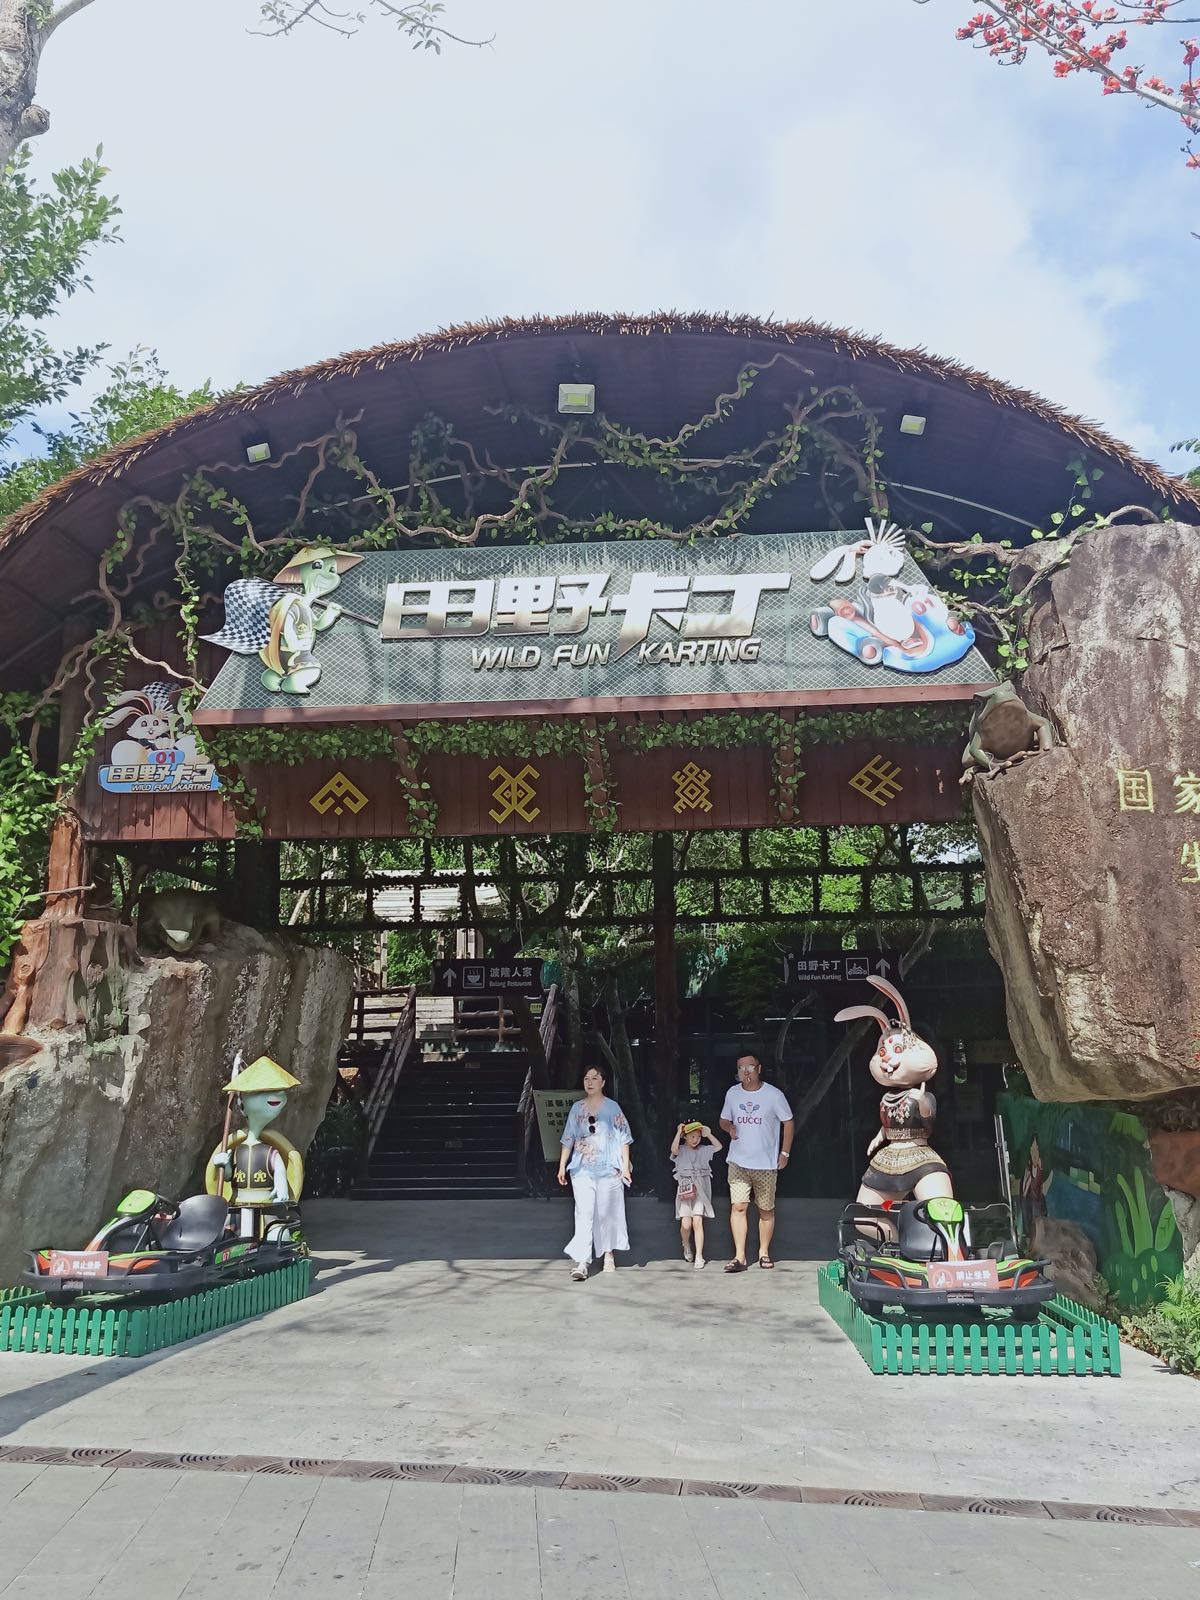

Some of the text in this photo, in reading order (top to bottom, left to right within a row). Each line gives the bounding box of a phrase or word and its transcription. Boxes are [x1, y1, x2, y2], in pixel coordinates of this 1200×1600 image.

[380, 571, 792, 662] 田野卡丁
[470, 638, 761, 670] WILD FUN KARTING
[155, 751, 176, 764] 01
[107, 764, 216, 789] 田野卡丁
[131, 783, 211, 791] WILD FUN KARTING
[798, 960, 840, 970] 田野卡丁
